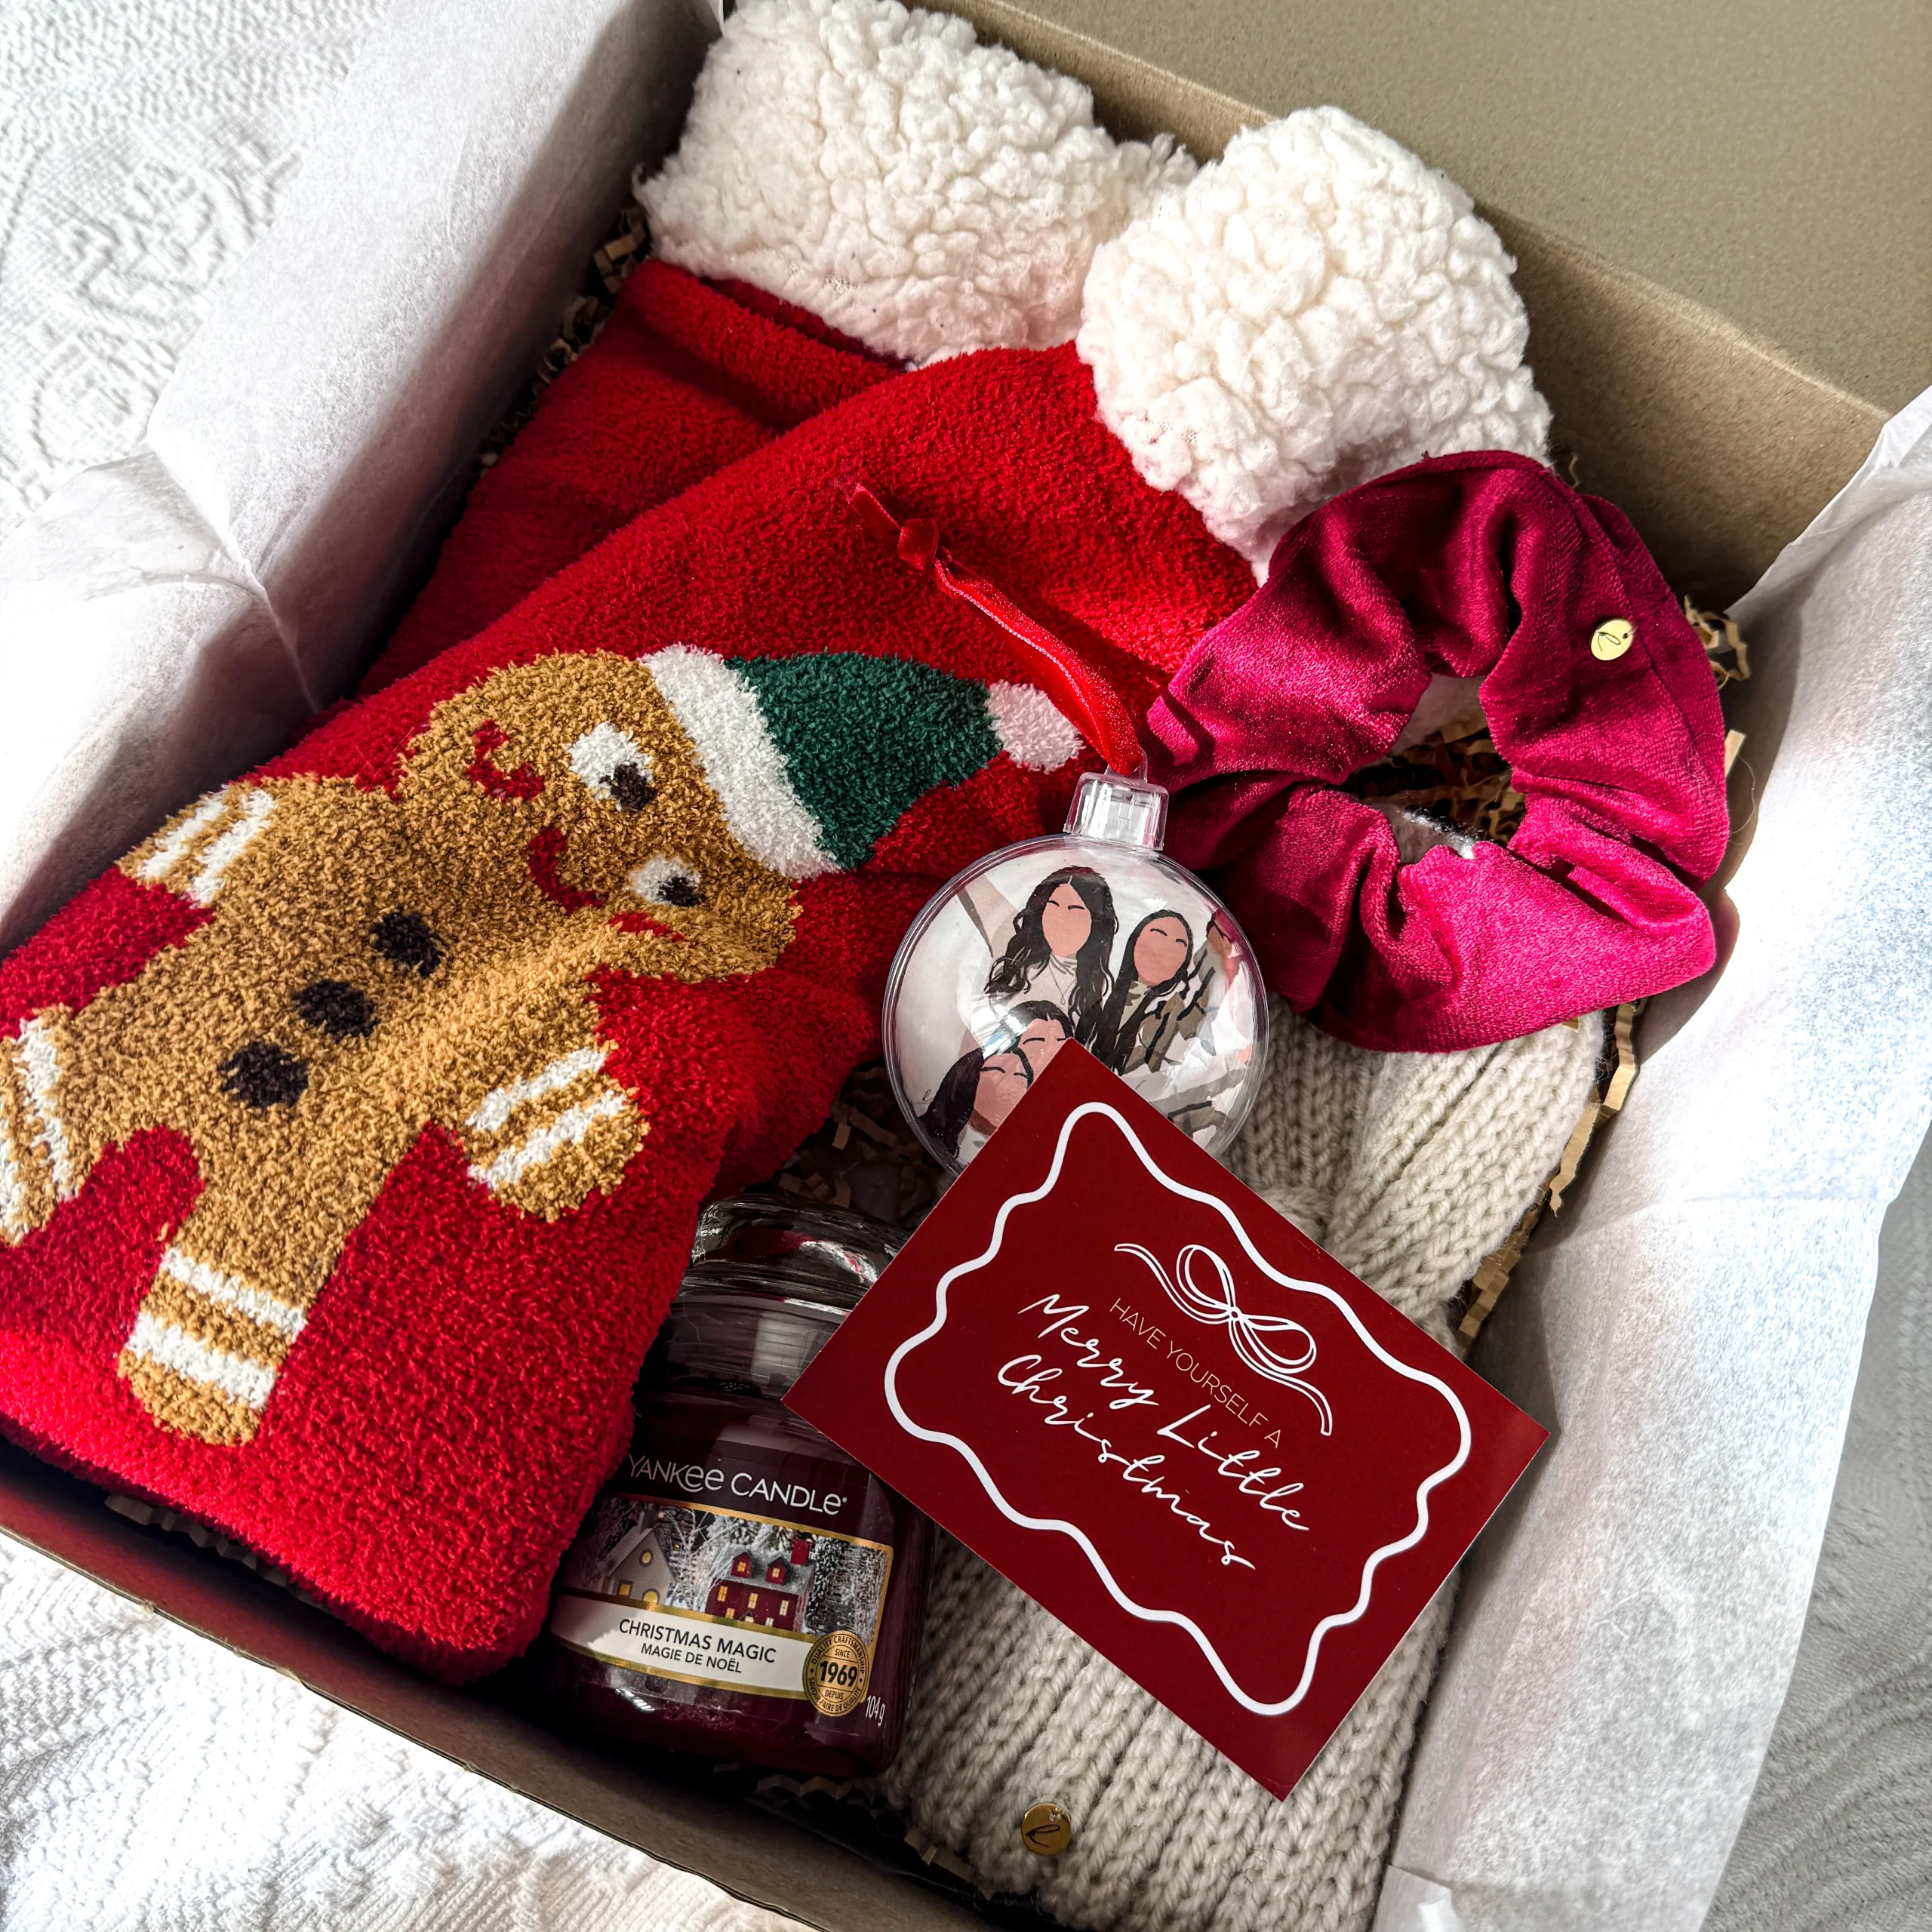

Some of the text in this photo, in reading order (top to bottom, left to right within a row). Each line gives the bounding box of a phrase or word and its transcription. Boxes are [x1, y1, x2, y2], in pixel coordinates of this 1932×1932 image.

[1109, 1297, 1281, 1449] HAVE YOURSELF A
[1017, 1294, 1310, 1531] Merry Little
[997, 1354, 1256, 1571] Christmas
[619, 1618, 777, 1664] CHRISTMAS MAGIC
[641, 1642, 742, 1674] MAGIE DE NOËL
[811, 1635, 865, 1674] QUALITY CRAFTSMANSHIP
[834, 1648, 851, 1658] SINCE
[820, 1660, 858, 1687] 1969
[824, 1689, 844, 1700] DEPUIS
